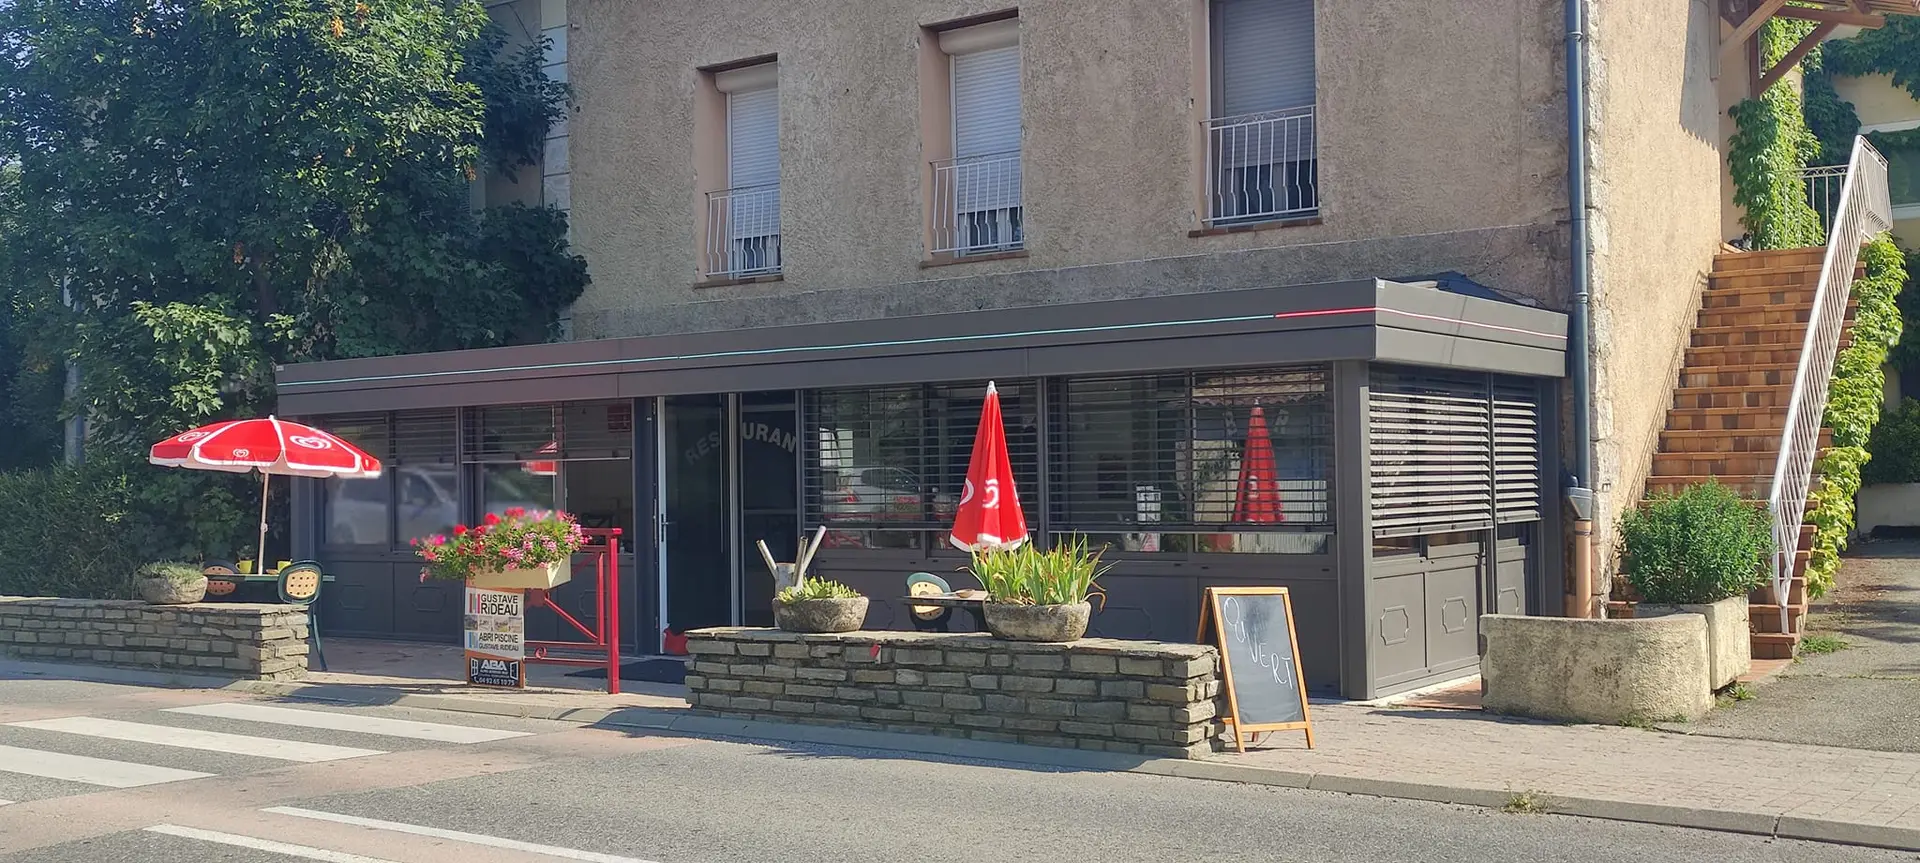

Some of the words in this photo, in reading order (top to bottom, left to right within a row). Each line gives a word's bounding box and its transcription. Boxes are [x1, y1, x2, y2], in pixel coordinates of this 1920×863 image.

[481, 594, 518, 604] GUSTAVE
[479, 632, 493, 642] ABRI
[494, 633, 518, 643] PISCINE
[1223, 597, 1293, 690] OUVERT
[481, 659, 507, 671] ABA
